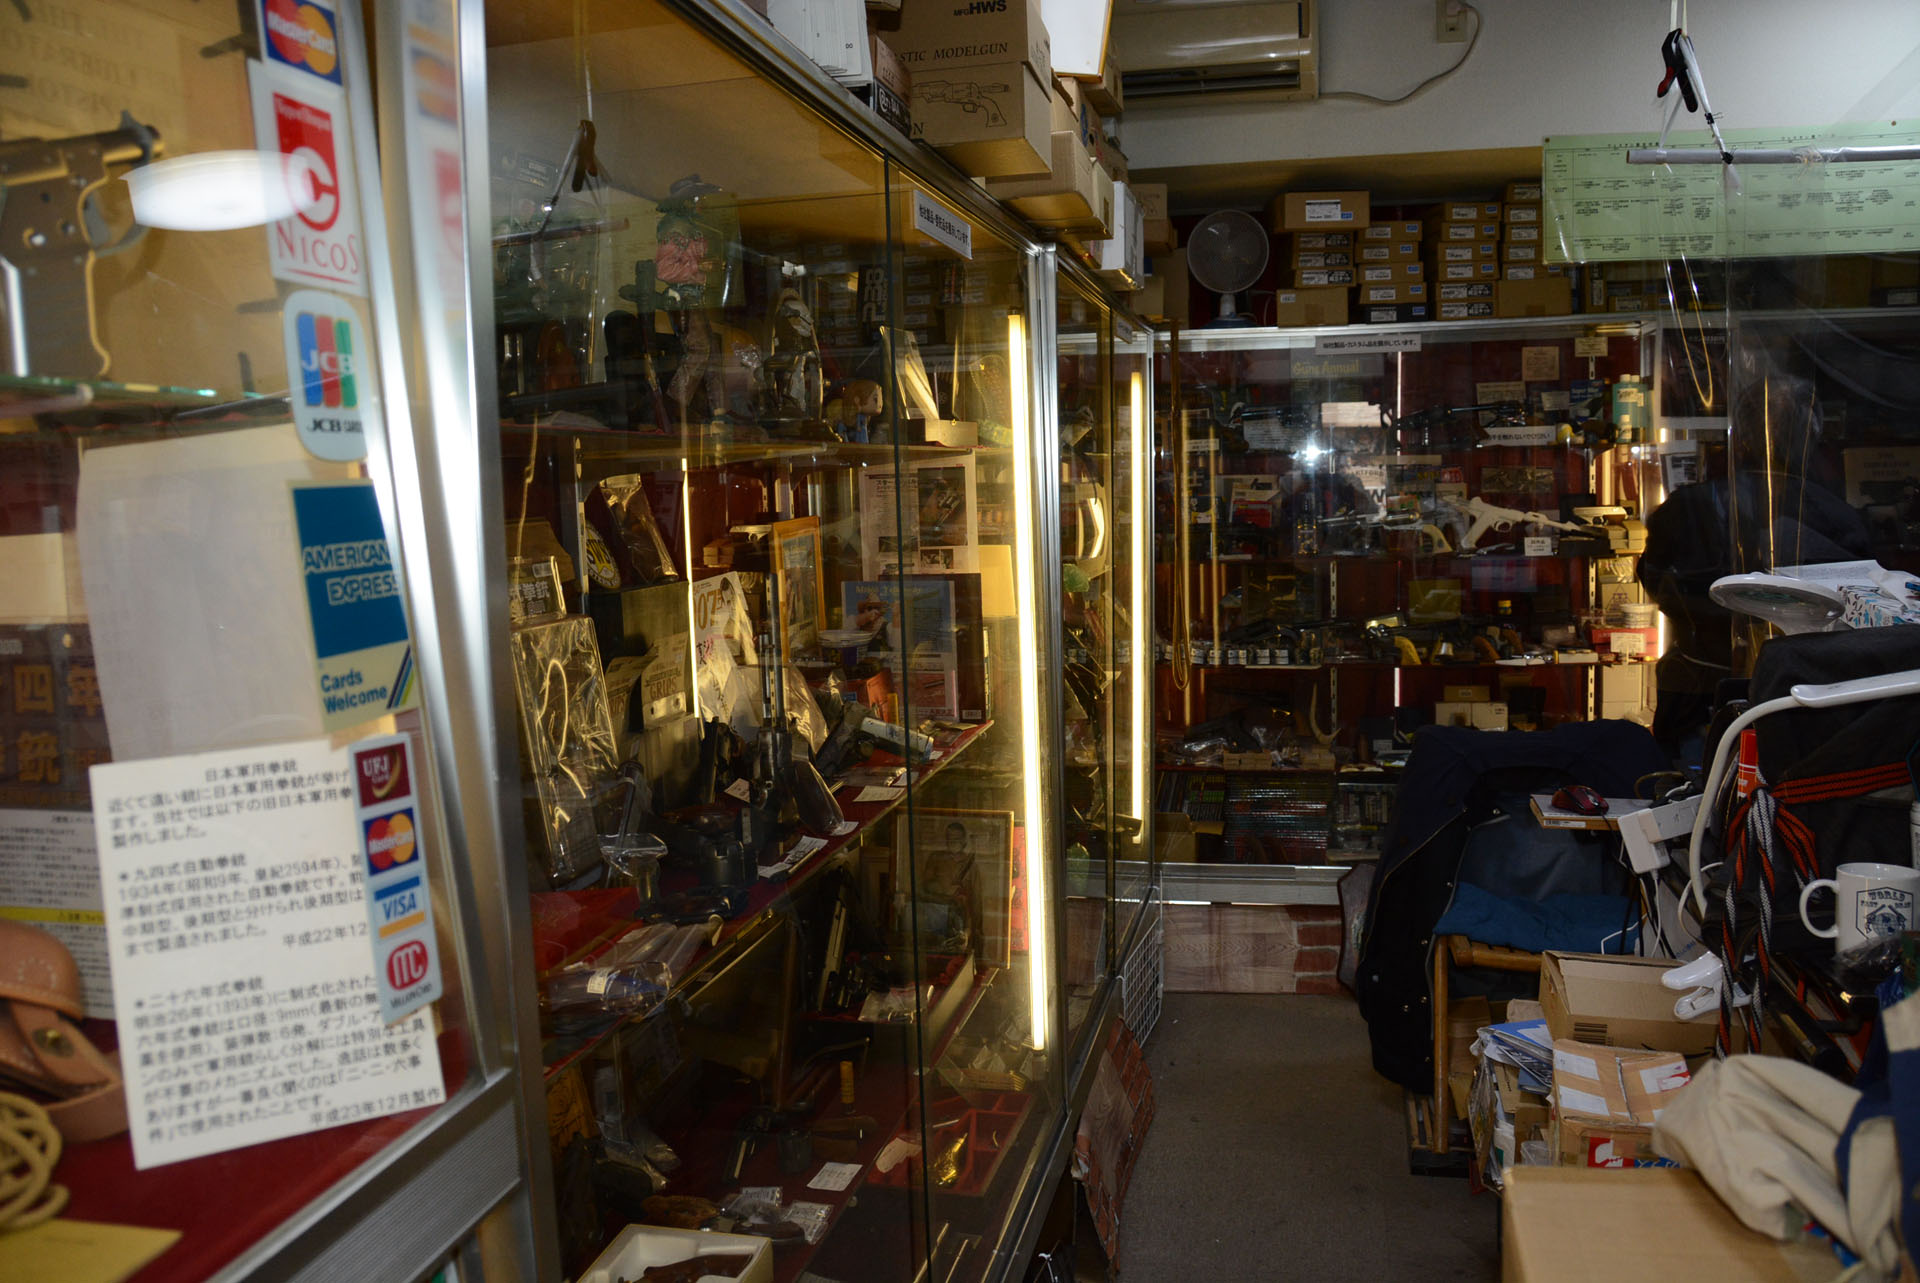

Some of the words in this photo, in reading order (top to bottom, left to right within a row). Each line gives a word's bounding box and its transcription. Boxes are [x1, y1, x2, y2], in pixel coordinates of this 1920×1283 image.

[969, 0, 1007, 14] HWS
[934, 43, 1008, 60] MODELGUN
[276, 220, 359, 274] NICOS
[301, 348, 356, 376] JCB
[303, 539, 392, 574] AMERICAN
[321, 668, 363, 693] Cards
[324, 685, 388, 714] Welcome
[204, 759, 298, 782] 日本軍用拳銃
[363, 757, 389, 777] UFJ
[112, 823, 208, 849] 製作しました。
[382, 893, 417, 920] VISA
[1868, 890, 1905, 901] WORLD
[124, 921, 267, 957] まで製造されました。
[309, 1086, 440, 1128] 平成23年12月製作
